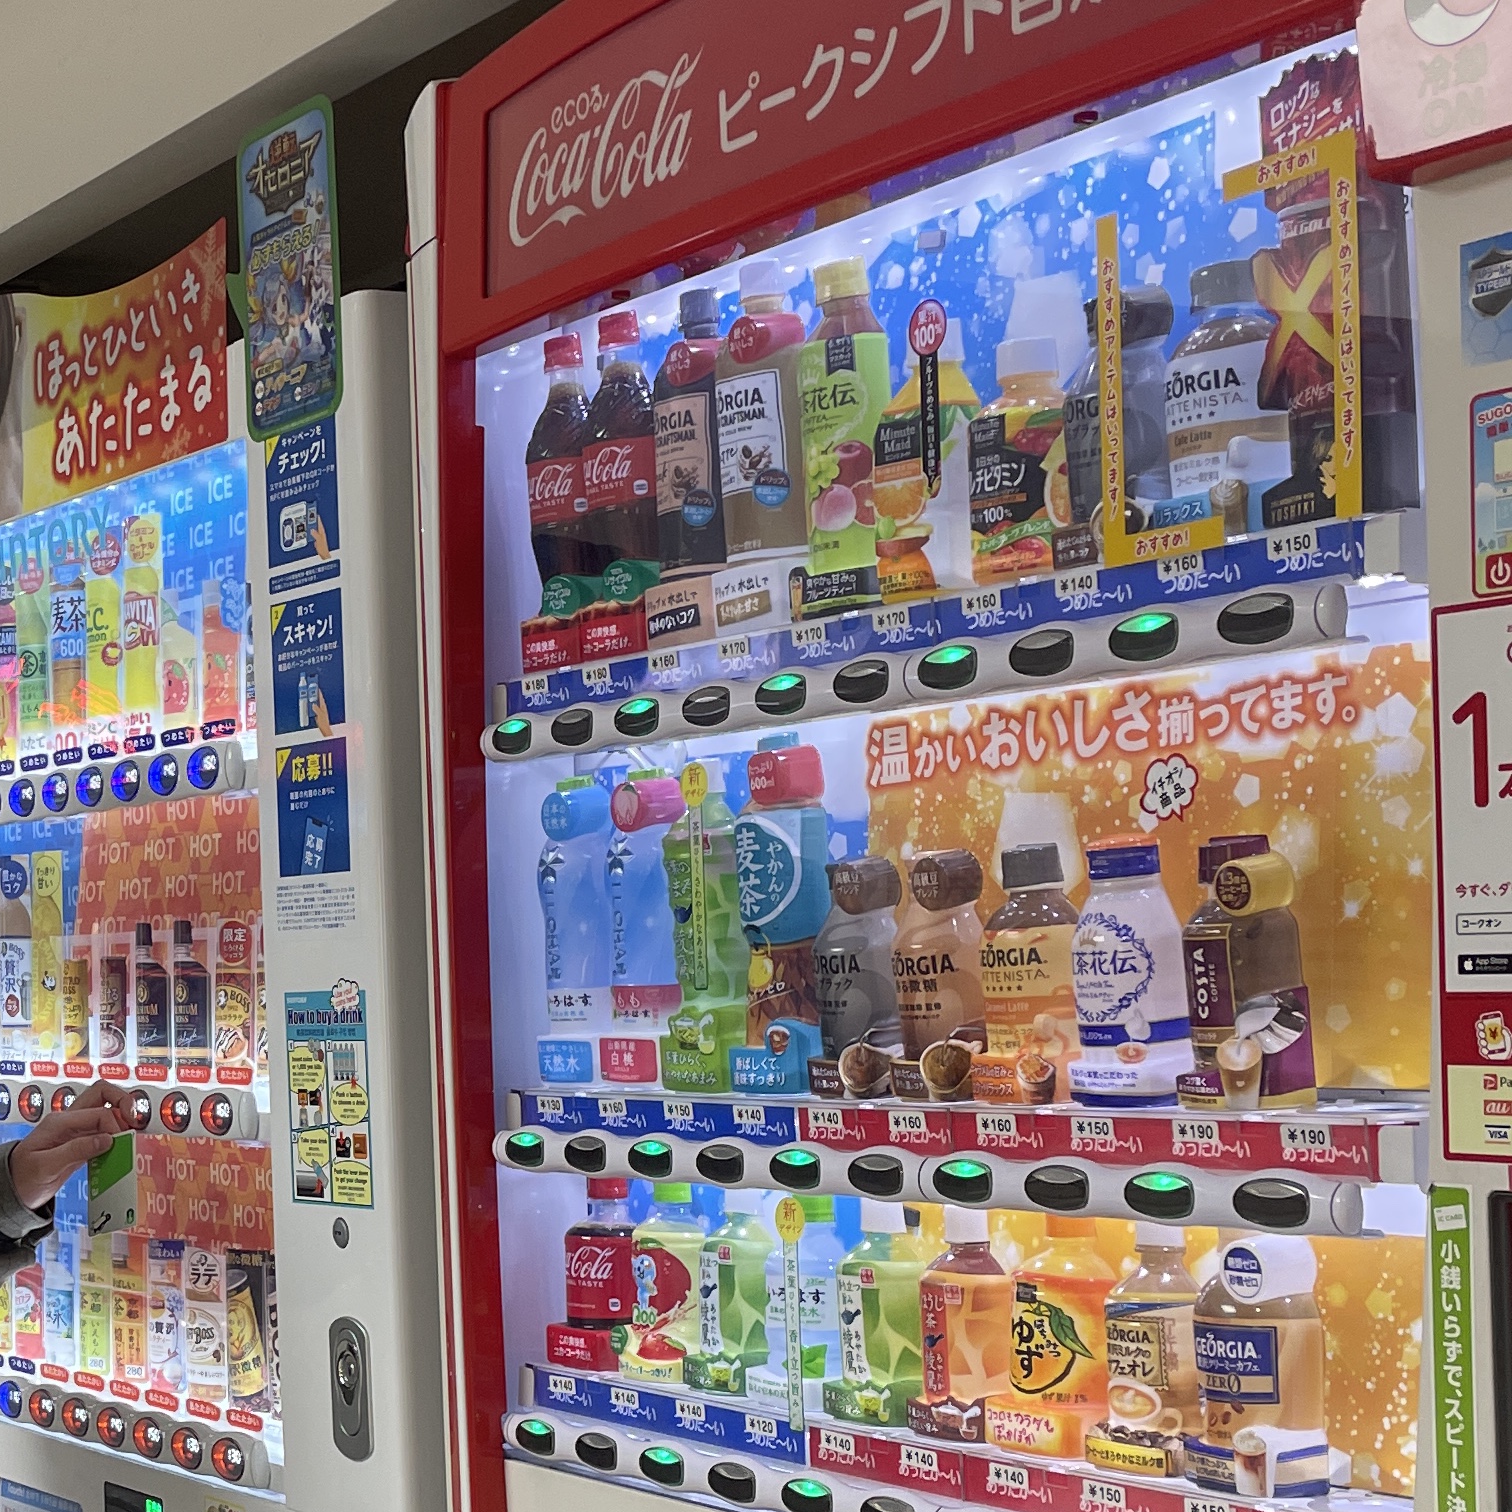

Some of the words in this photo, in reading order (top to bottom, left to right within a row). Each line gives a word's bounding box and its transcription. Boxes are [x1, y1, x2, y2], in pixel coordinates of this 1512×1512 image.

[509, 43, 704, 247] Coca-Cola
[1257, 147, 1317, 184] おすすめ!
[35, 267, 201, 400] ほっとひといき
[913, 323, 943, 348] 100%
[53, 344, 213, 477] あたたまる
[879, 425, 916, 442] Minute
[884, 437, 912, 455] Maid
[278, 438, 326, 474] チェック!
[170, 491, 193, 514] ICE
[208, 477, 233, 503] ICE
[1156, 500, 1203, 526] リラックス
[188, 522, 214, 548] ICE
[1136, 529, 1190, 556] おすすめ!
[170, 569, 194, 593] ICE
[208, 557, 235, 582] ICE
[282, 612, 334, 649] スキャン!
[60, 638, 84, 657] 600
[868, 672, 1359, 789] 温かいおいしさ揃ってます。
[291, 751, 334, 785] 応募!!
[687, 766, 701, 786] 新
[750, 774, 776, 790] 600ml
[1151, 767, 1184, 795] イチオシ
[166, 799, 197, 820] HOT
[98, 839, 131, 863] HOT
[143, 837, 177, 863] HOT
[189, 833, 223, 858] HOT
[211, 870, 245, 895] HOT
[735, 828, 765, 916] 麦茶
[766, 840, 785, 903] やかんの
[4, 882, 20, 893] コク
[119, 877, 152, 901] HOT
[165, 875, 198, 899] HOT
[223, 927, 246, 943] 限定
[1461, 918, 1502, 928] コークオン
[4, 960, 16, 993] 贅沢
[1194, 948, 1209, 1019] COSTA
[1211, 963, 1219, 1002] COFFEE
[230, 989, 251, 1014] BOSS
[288, 1009, 305, 1026] How
[306, 1010, 315, 1024] to
[316, 1010, 332, 1027] buy
[340, 1009, 363, 1024] drink
[543, 1049, 581, 1073] 天然水
[609, 1051, 636, 1067] 白桃
[1489, 1130, 1509, 1139] VISA
[782, 1201, 797, 1222] 新
[190, 1267, 219, 1285] ラテ
[1013, 1316, 1045, 1378] ゆず
[1196, 1331, 1258, 1359] GEORGIA
